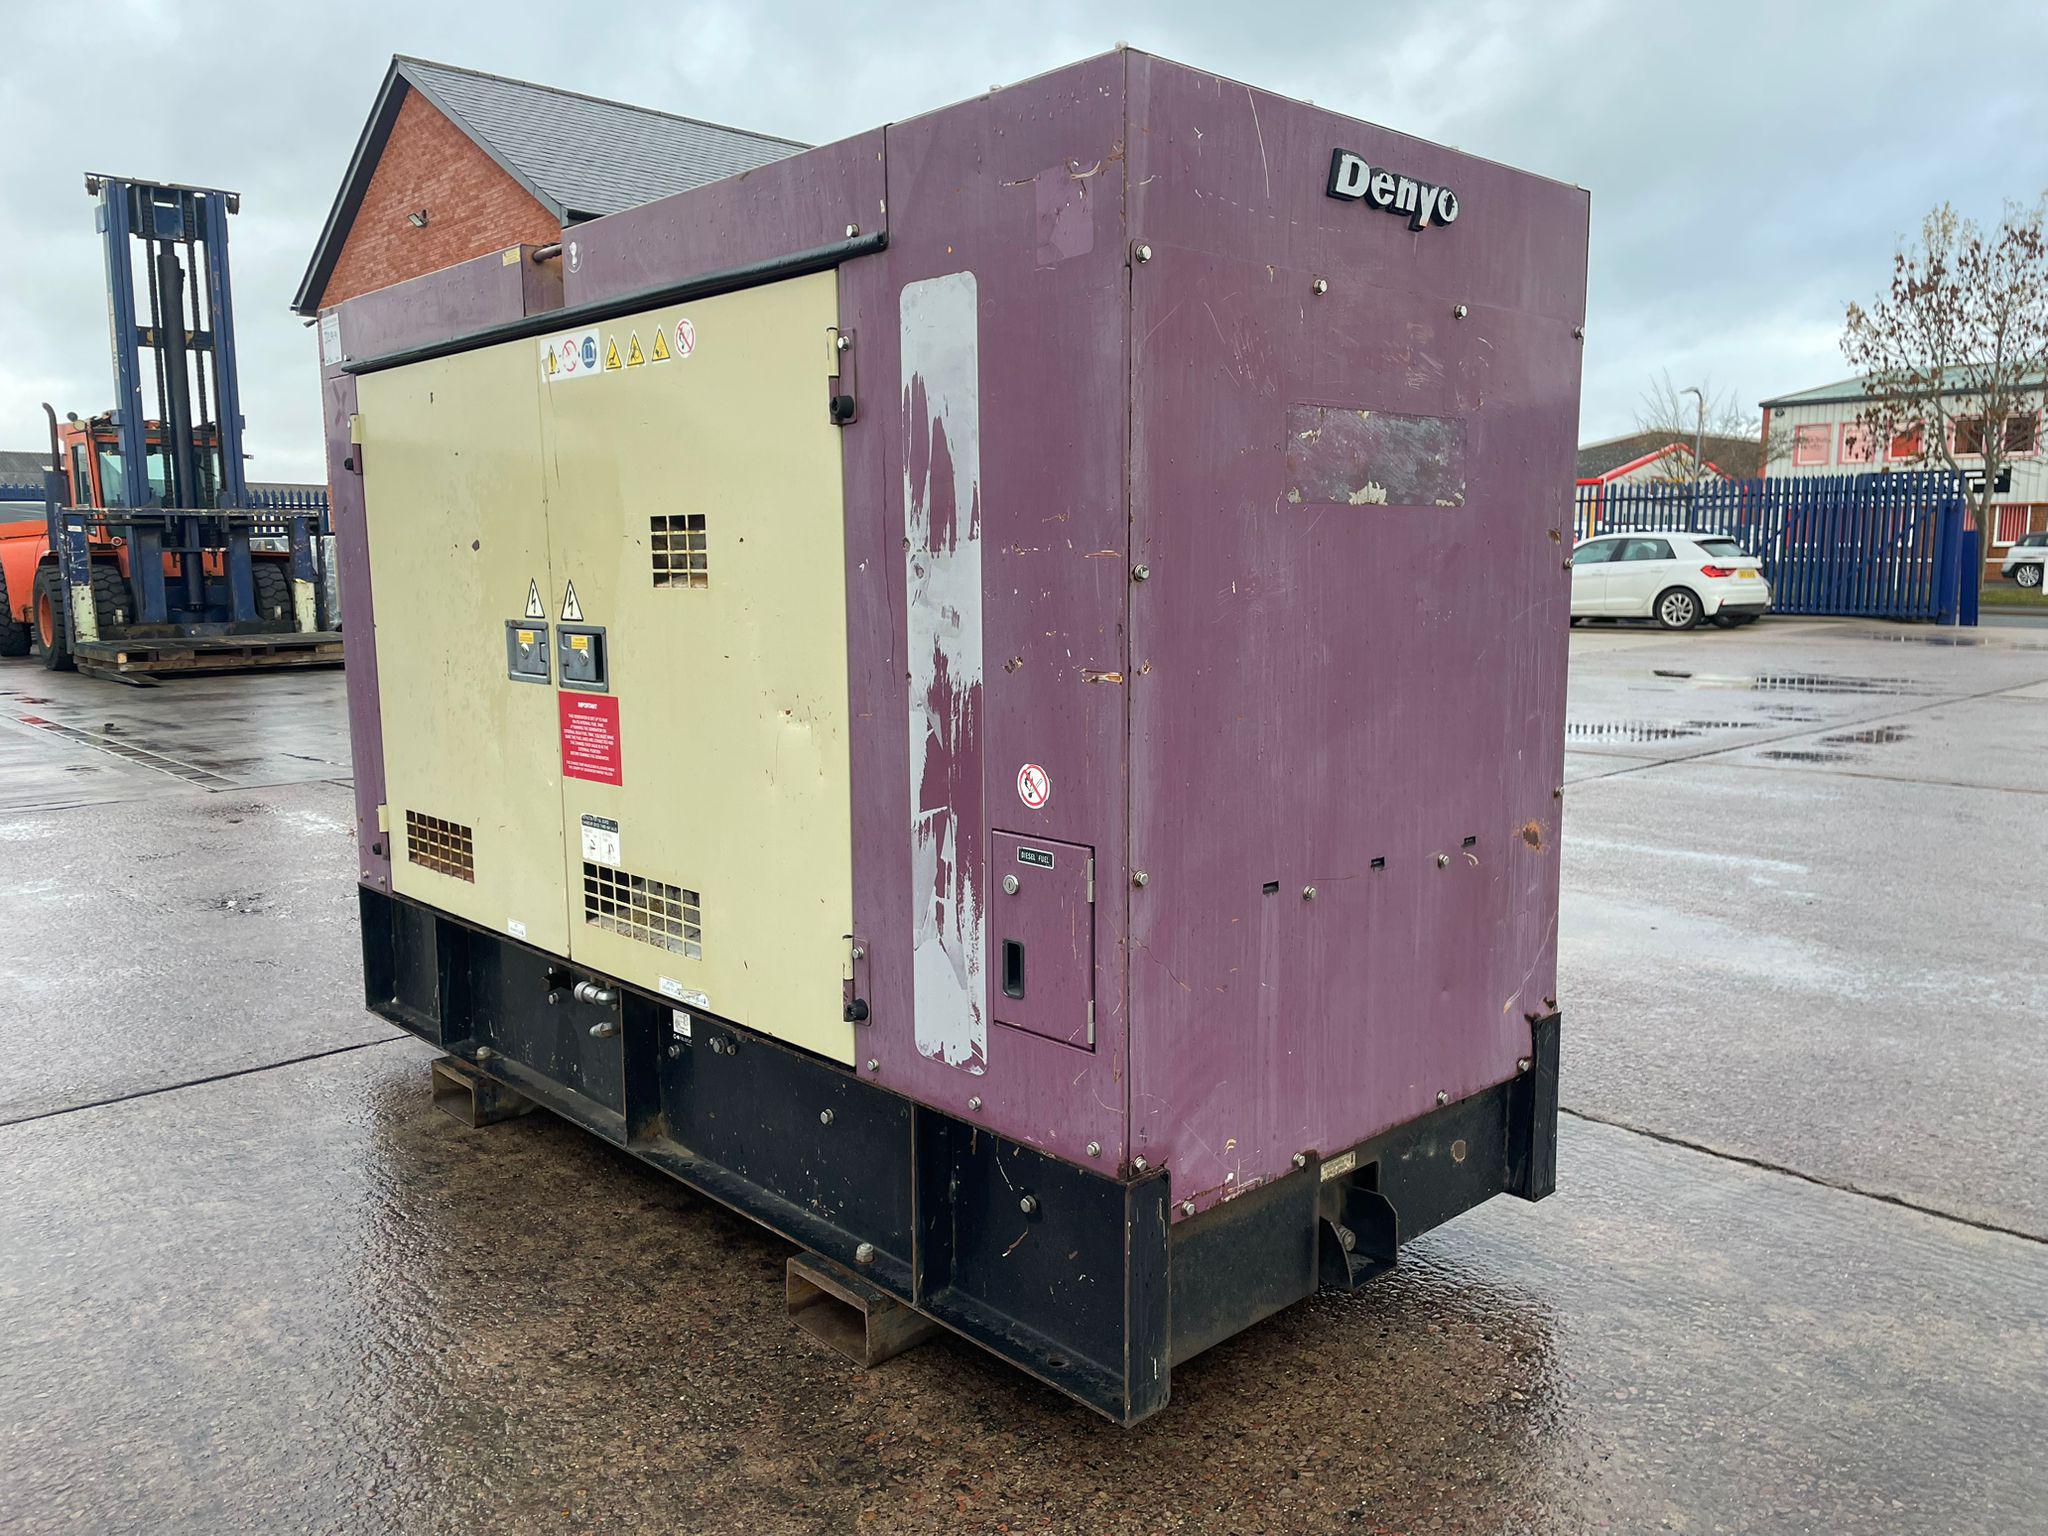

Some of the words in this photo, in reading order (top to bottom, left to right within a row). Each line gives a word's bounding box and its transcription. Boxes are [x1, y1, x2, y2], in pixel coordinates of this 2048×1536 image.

[1328, 149, 1459, 230] Denyo
[1021, 851, 1036, 861] DIESEL
[1038, 855, 1050, 864] FUEL
